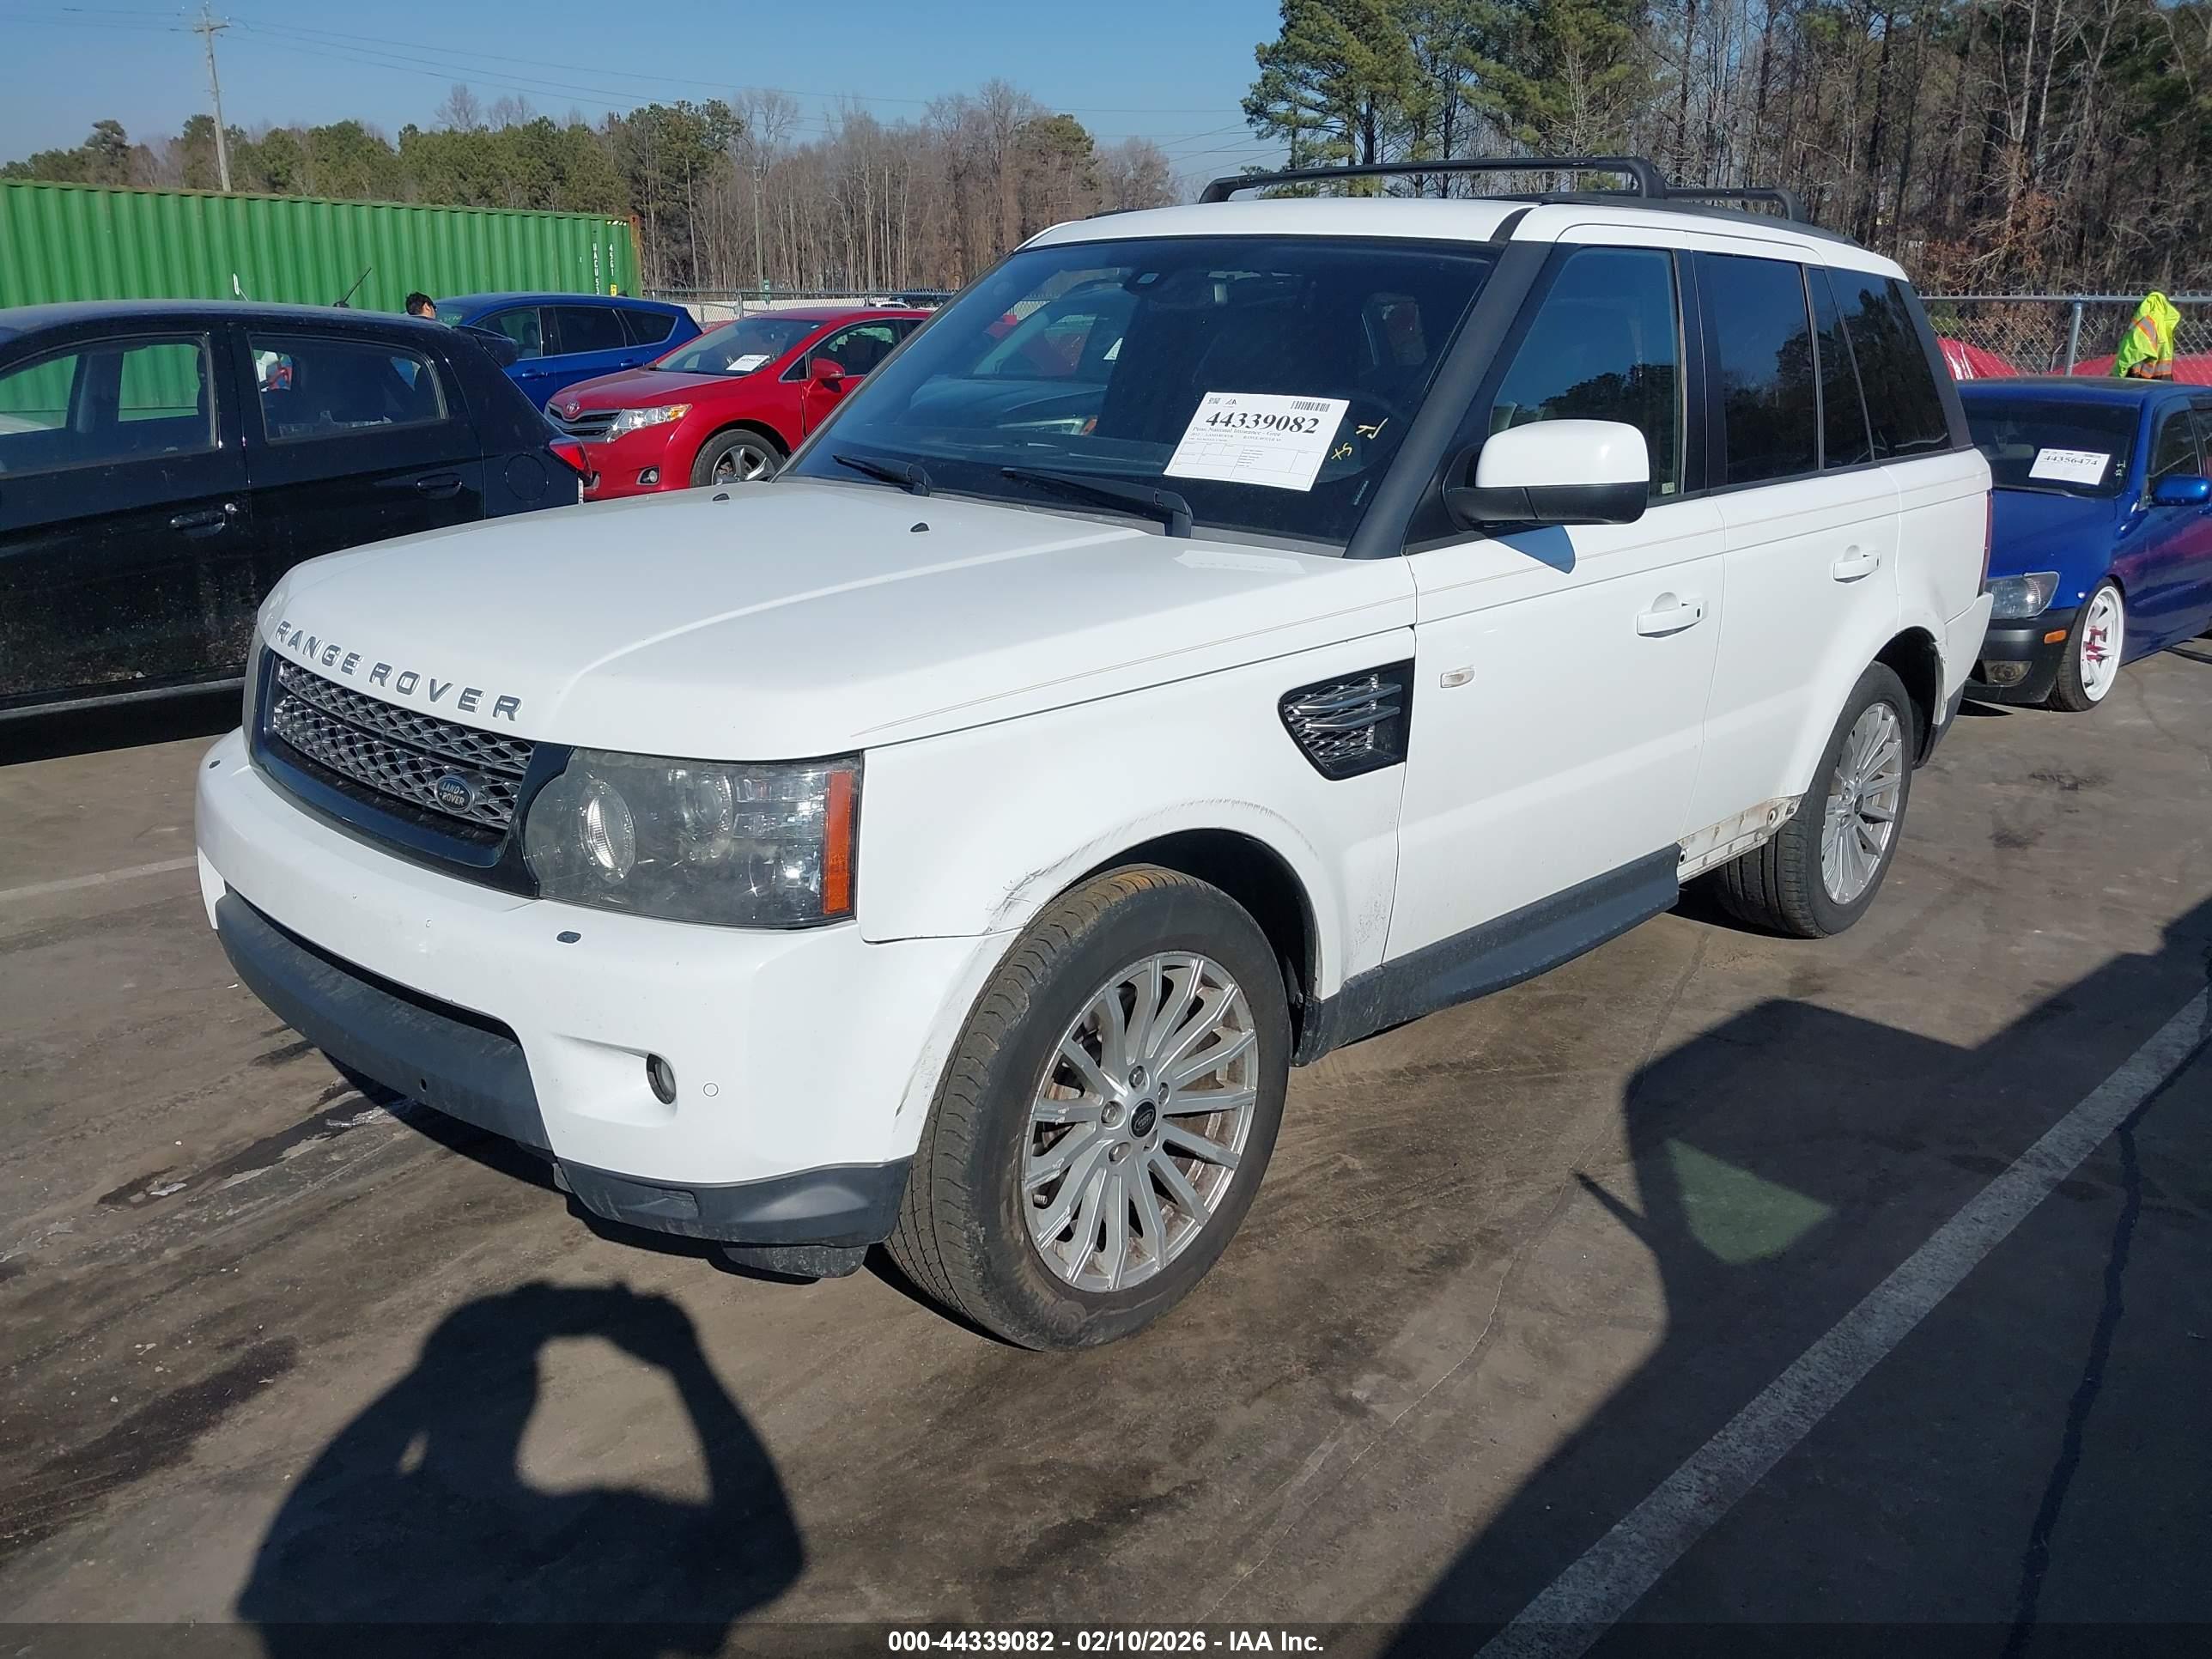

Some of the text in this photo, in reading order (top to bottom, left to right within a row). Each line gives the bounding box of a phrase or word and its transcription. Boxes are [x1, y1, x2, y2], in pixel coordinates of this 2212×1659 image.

[1206, 411, 1320, 434] 44339082
[2044, 455, 2098, 465] 44356474
[275, 620, 523, 722] RANGE ROVER
[441, 782, 460, 794] LAND
[441, 791, 465, 807] ROVER
